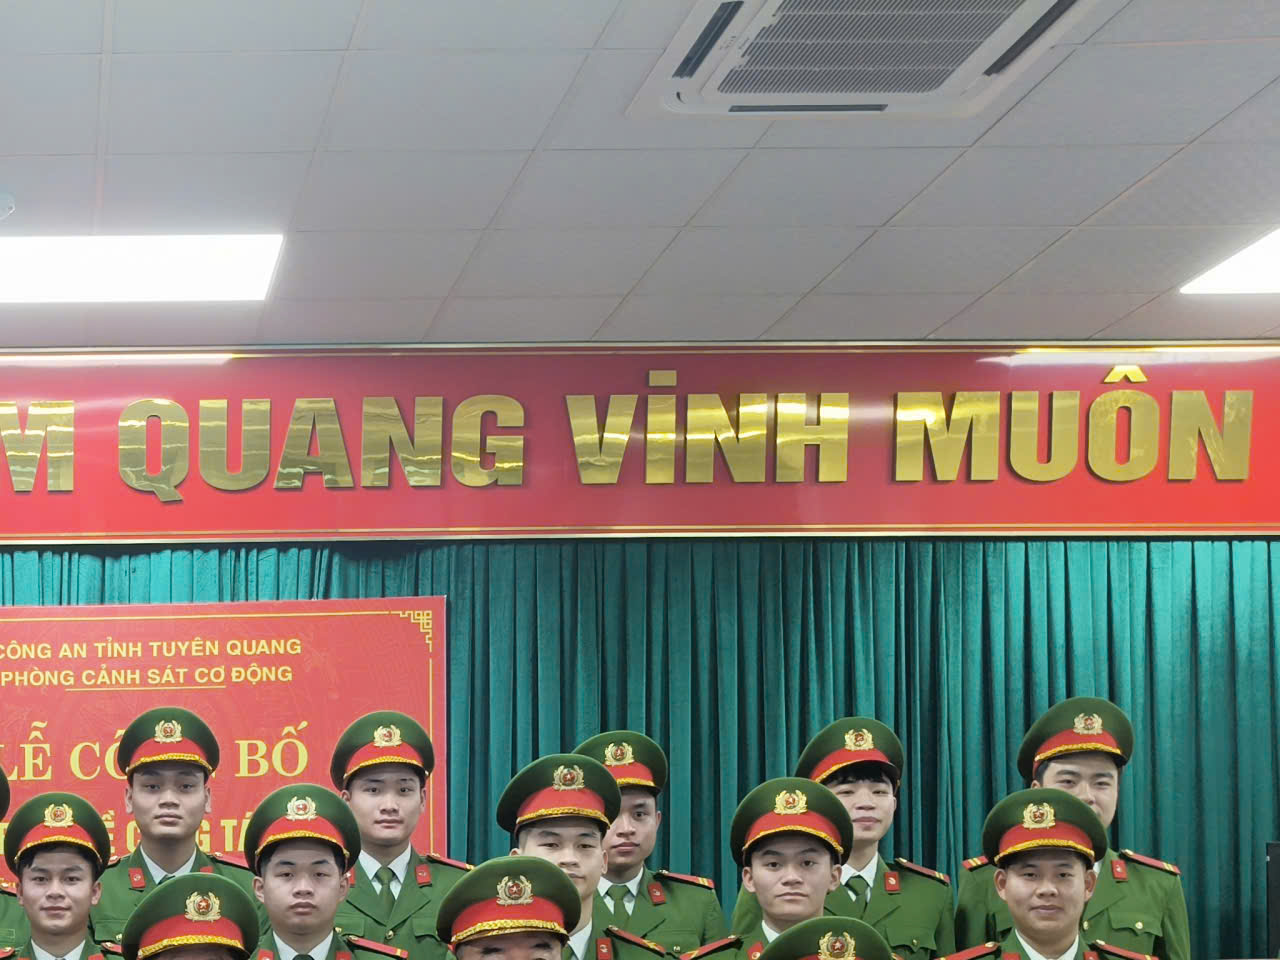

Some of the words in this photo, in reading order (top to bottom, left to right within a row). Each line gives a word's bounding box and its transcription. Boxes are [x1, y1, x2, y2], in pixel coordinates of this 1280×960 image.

[118, 394, 525, 501] QUANG
[895, 365, 1254, 481] MUÔN
[58, 642, 87, 658] AN
[94, 636, 142, 658] TỈNH
[149, 636, 219, 657] TUYÊN
[226, 638, 302, 656] QUANG
[1, 666, 75, 686] PHÒNG
[81, 664, 140, 685] CẢNH
[147, 665, 188, 684] SÁT
[194, 665, 225, 683] CƠ
[231, 663, 293, 685] ĐỘNG
[234, 720, 309, 777] BỐ
